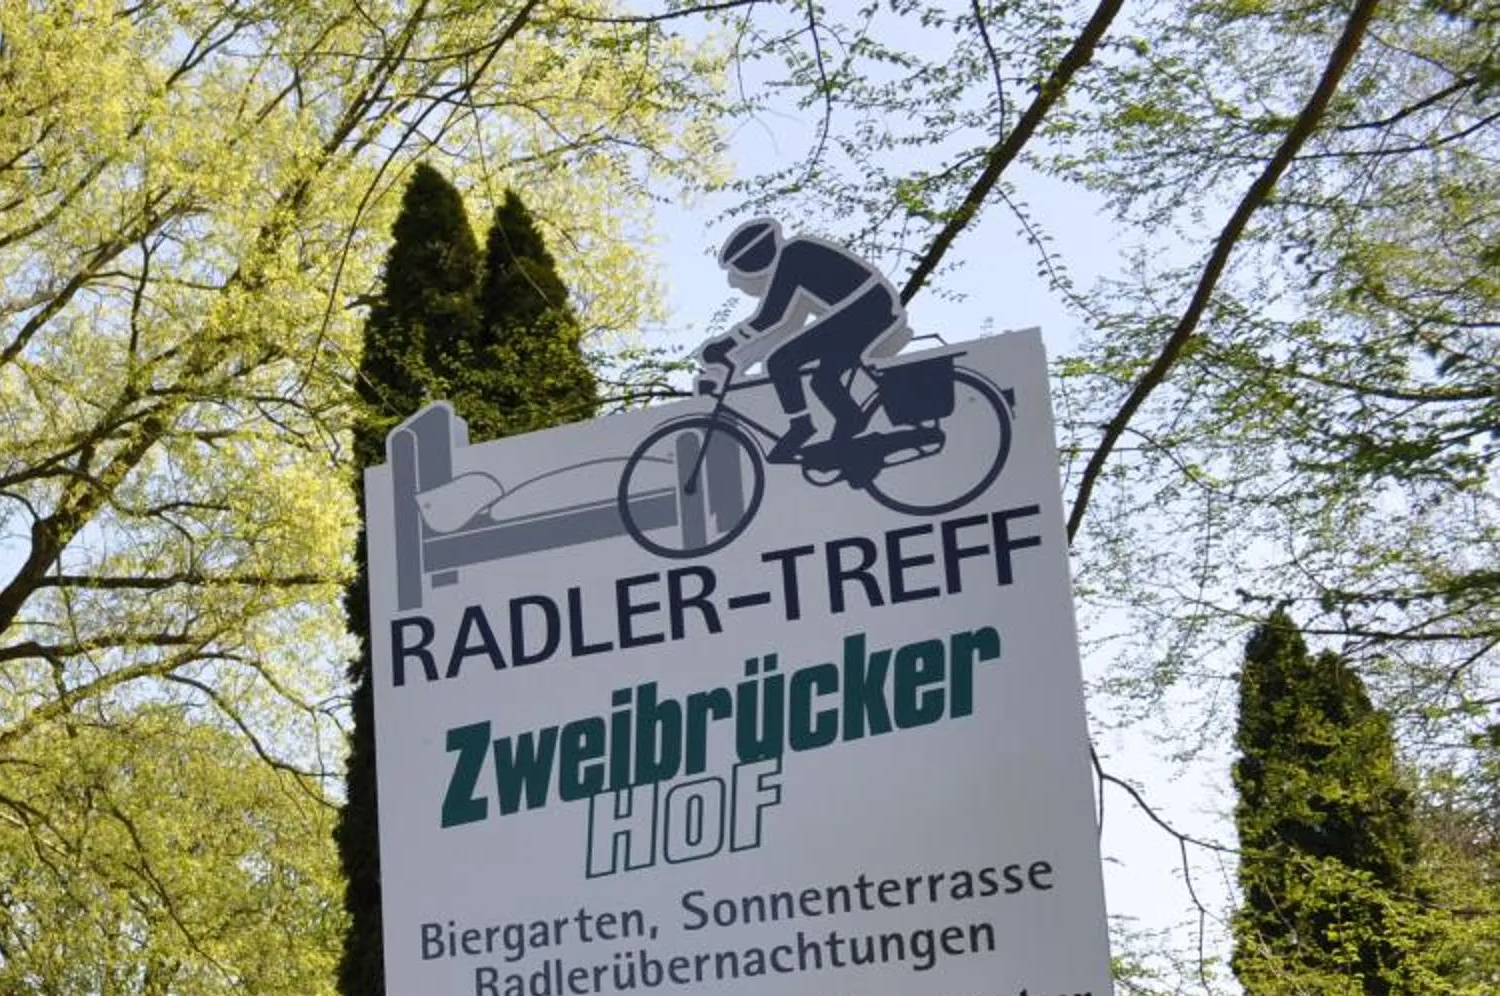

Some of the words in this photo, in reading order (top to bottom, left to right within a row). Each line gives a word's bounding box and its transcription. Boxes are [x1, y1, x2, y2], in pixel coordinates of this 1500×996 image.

[390, 504, 1042, 687] RADLER-TREFF
[440, 625, 1001, 829] Zweibrücker
[585, 756, 783, 878] HOF
[420, 907, 660, 962] Biergarten,
[682, 860, 1055, 931] Sonnenterrasse
